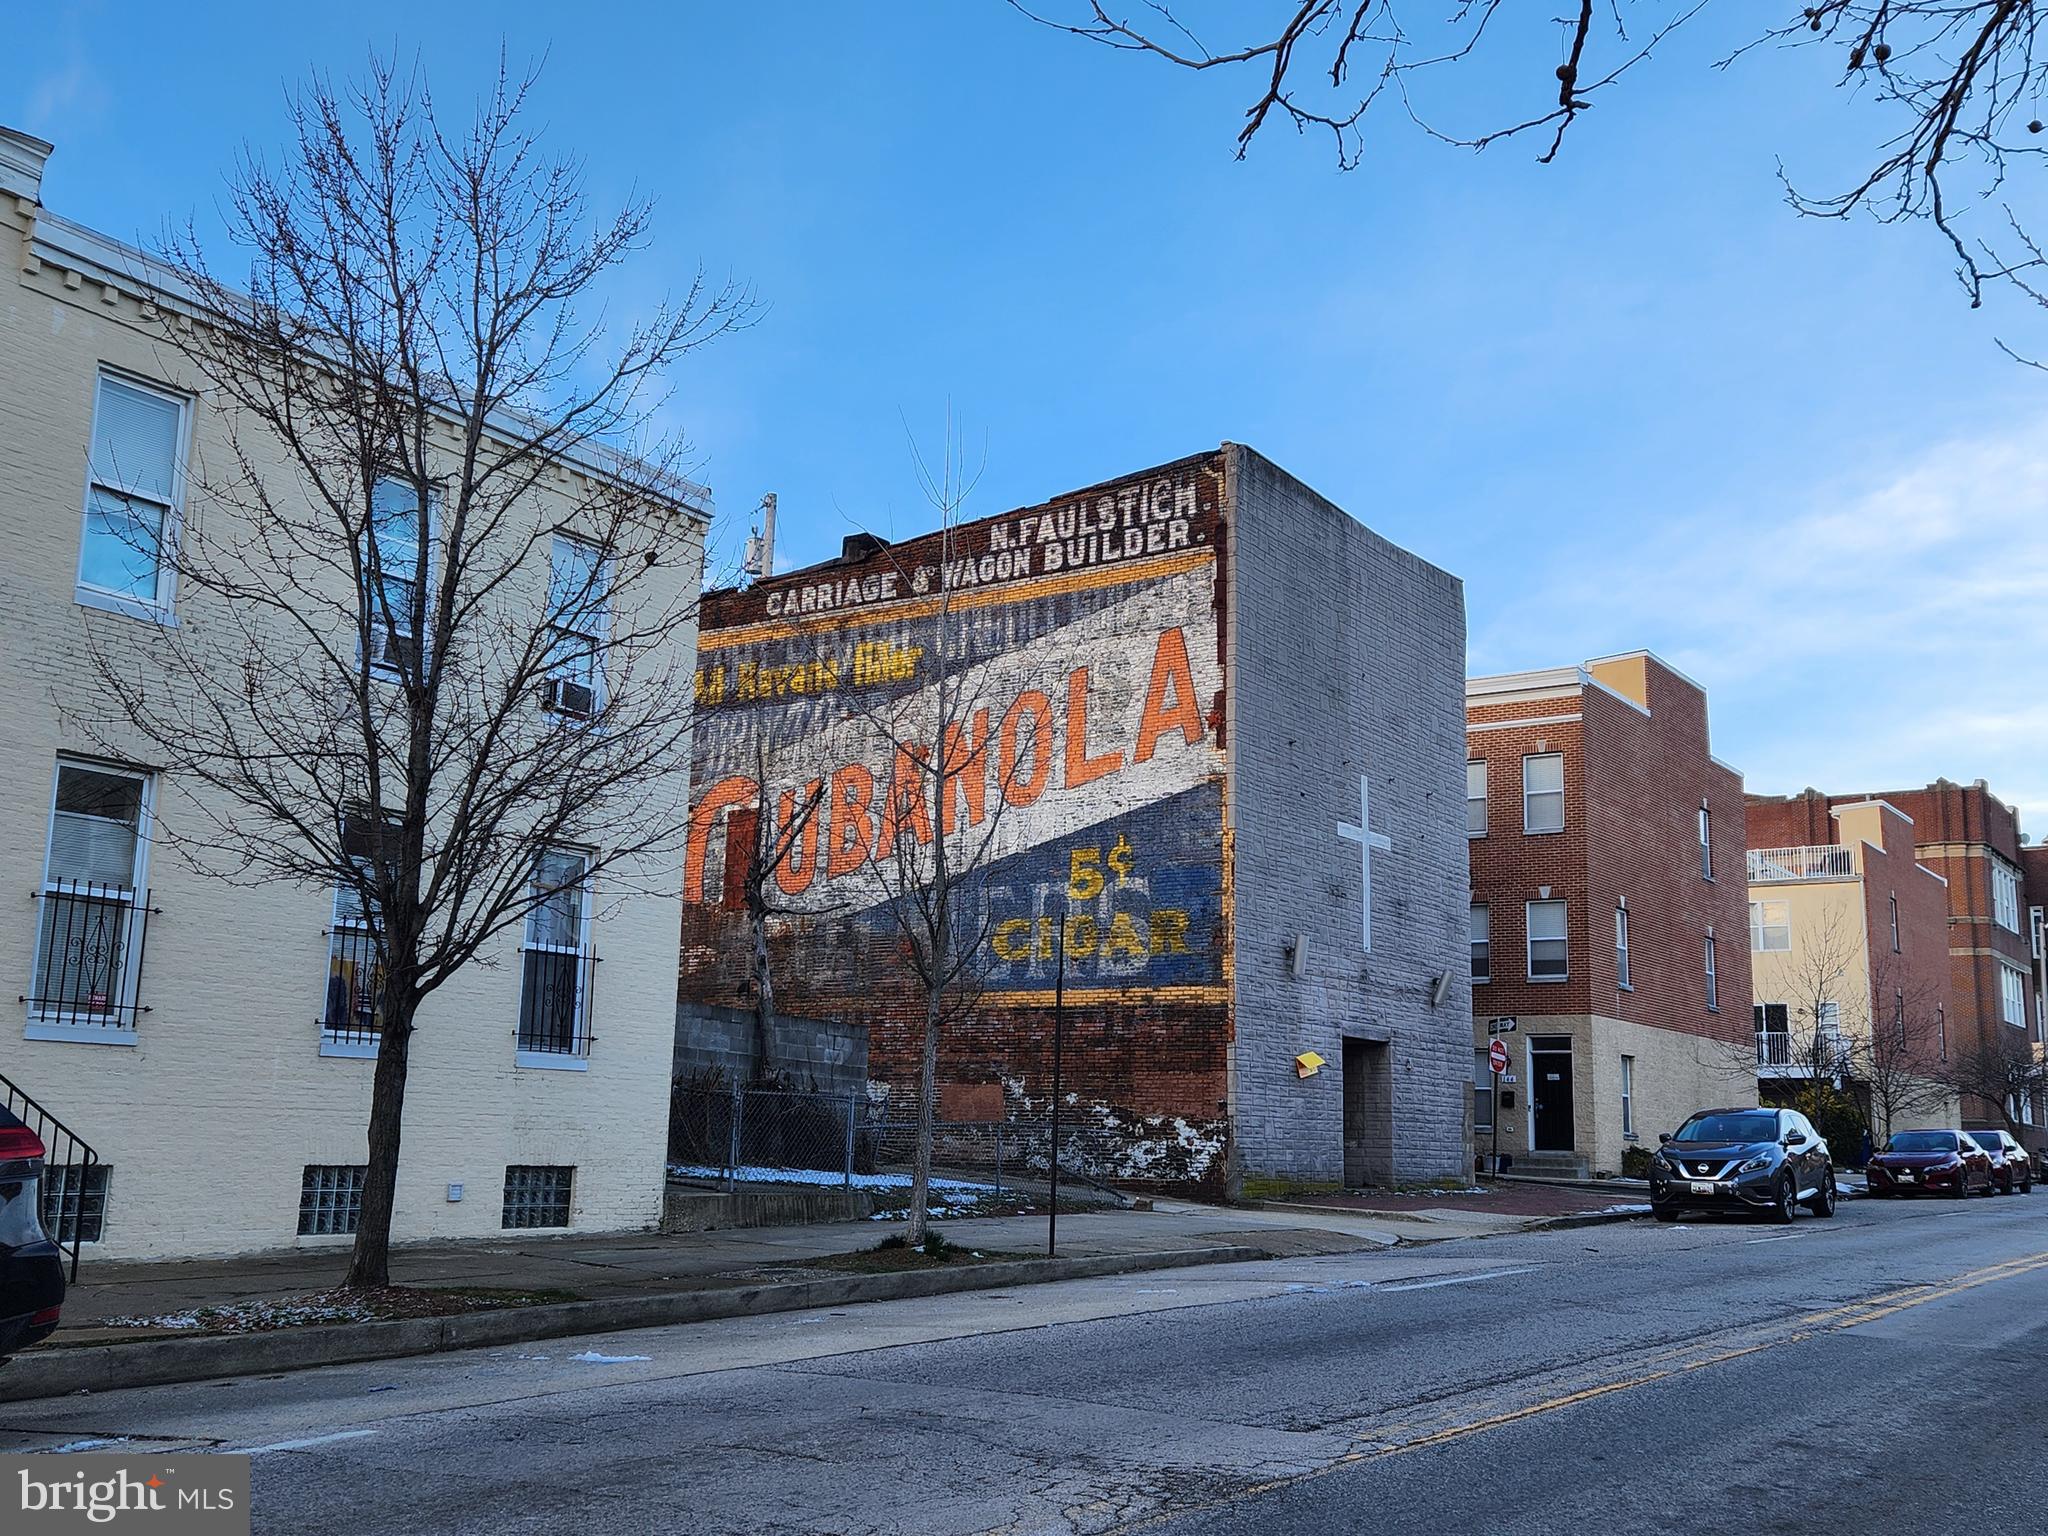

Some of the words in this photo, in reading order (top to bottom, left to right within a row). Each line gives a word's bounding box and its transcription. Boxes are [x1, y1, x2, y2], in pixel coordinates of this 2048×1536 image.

[766, 571, 898, 617] CARRIAGE
[941, 546, 1031, 590] WAGON
[683, 626, 1202, 902] CUBANOLA
[991, 909, 1191, 961] CIGAR
